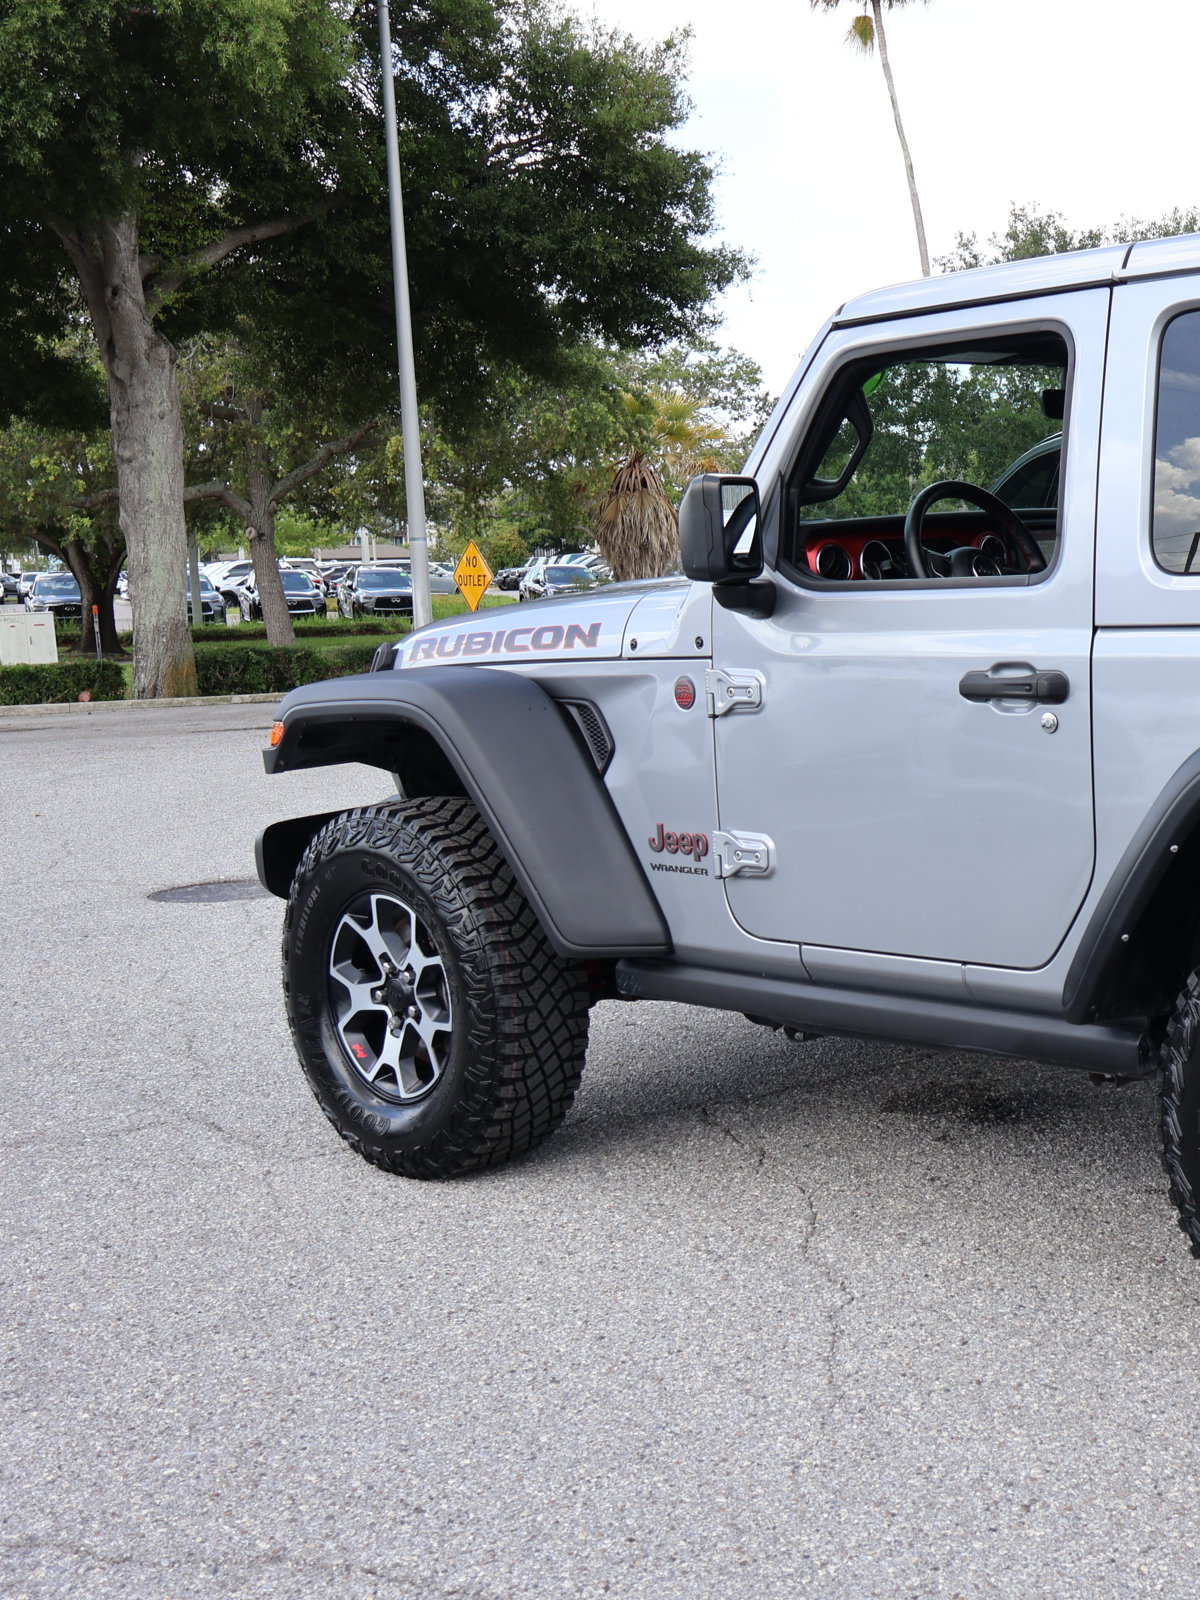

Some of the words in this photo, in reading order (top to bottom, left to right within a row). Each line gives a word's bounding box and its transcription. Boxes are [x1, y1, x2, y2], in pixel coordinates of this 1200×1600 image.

[465, 556, 478, 568] NO
[458, 575, 487, 586] OUTLET
[408, 622, 602, 661] RUBICON
[648, 822, 709, 862] Jeep
[650, 862, 709, 876] WRANGLER
